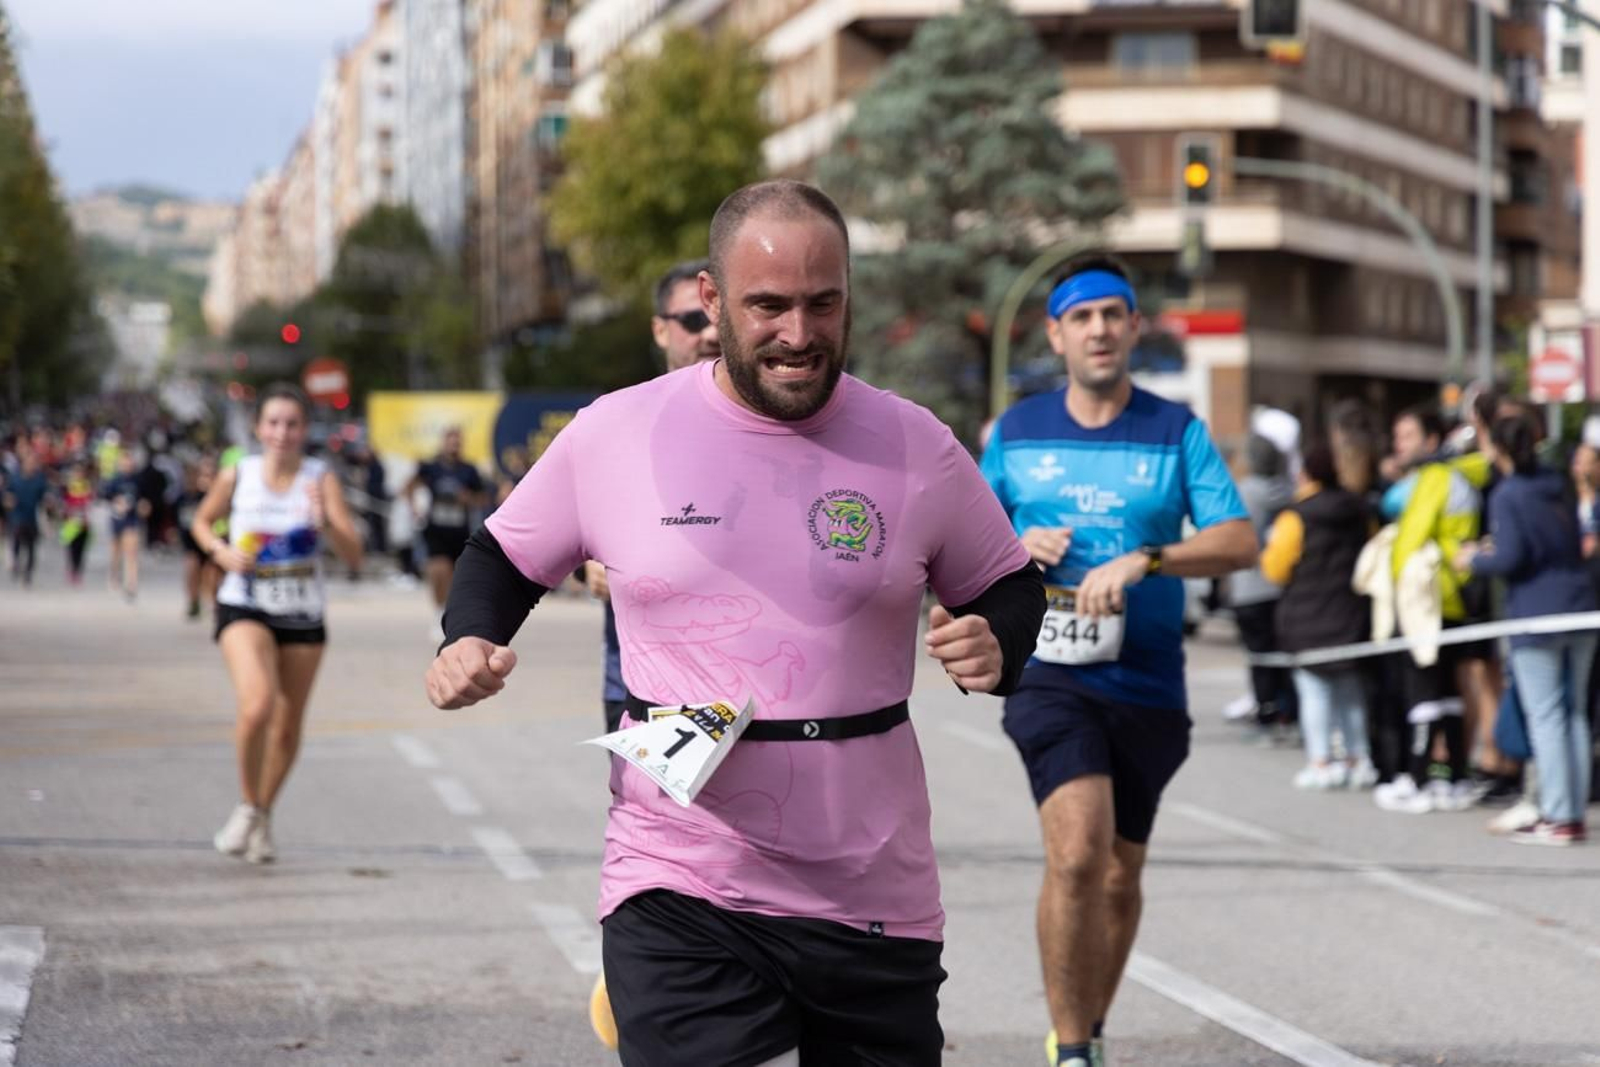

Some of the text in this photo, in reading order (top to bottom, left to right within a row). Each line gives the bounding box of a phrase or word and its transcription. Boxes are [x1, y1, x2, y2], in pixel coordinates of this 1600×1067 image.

[825, 489, 877, 511] DEPORTIVA
[660, 516, 722, 526] TEAMERGY
[1041, 616, 1102, 646] 544
[663, 726, 698, 760] 1
